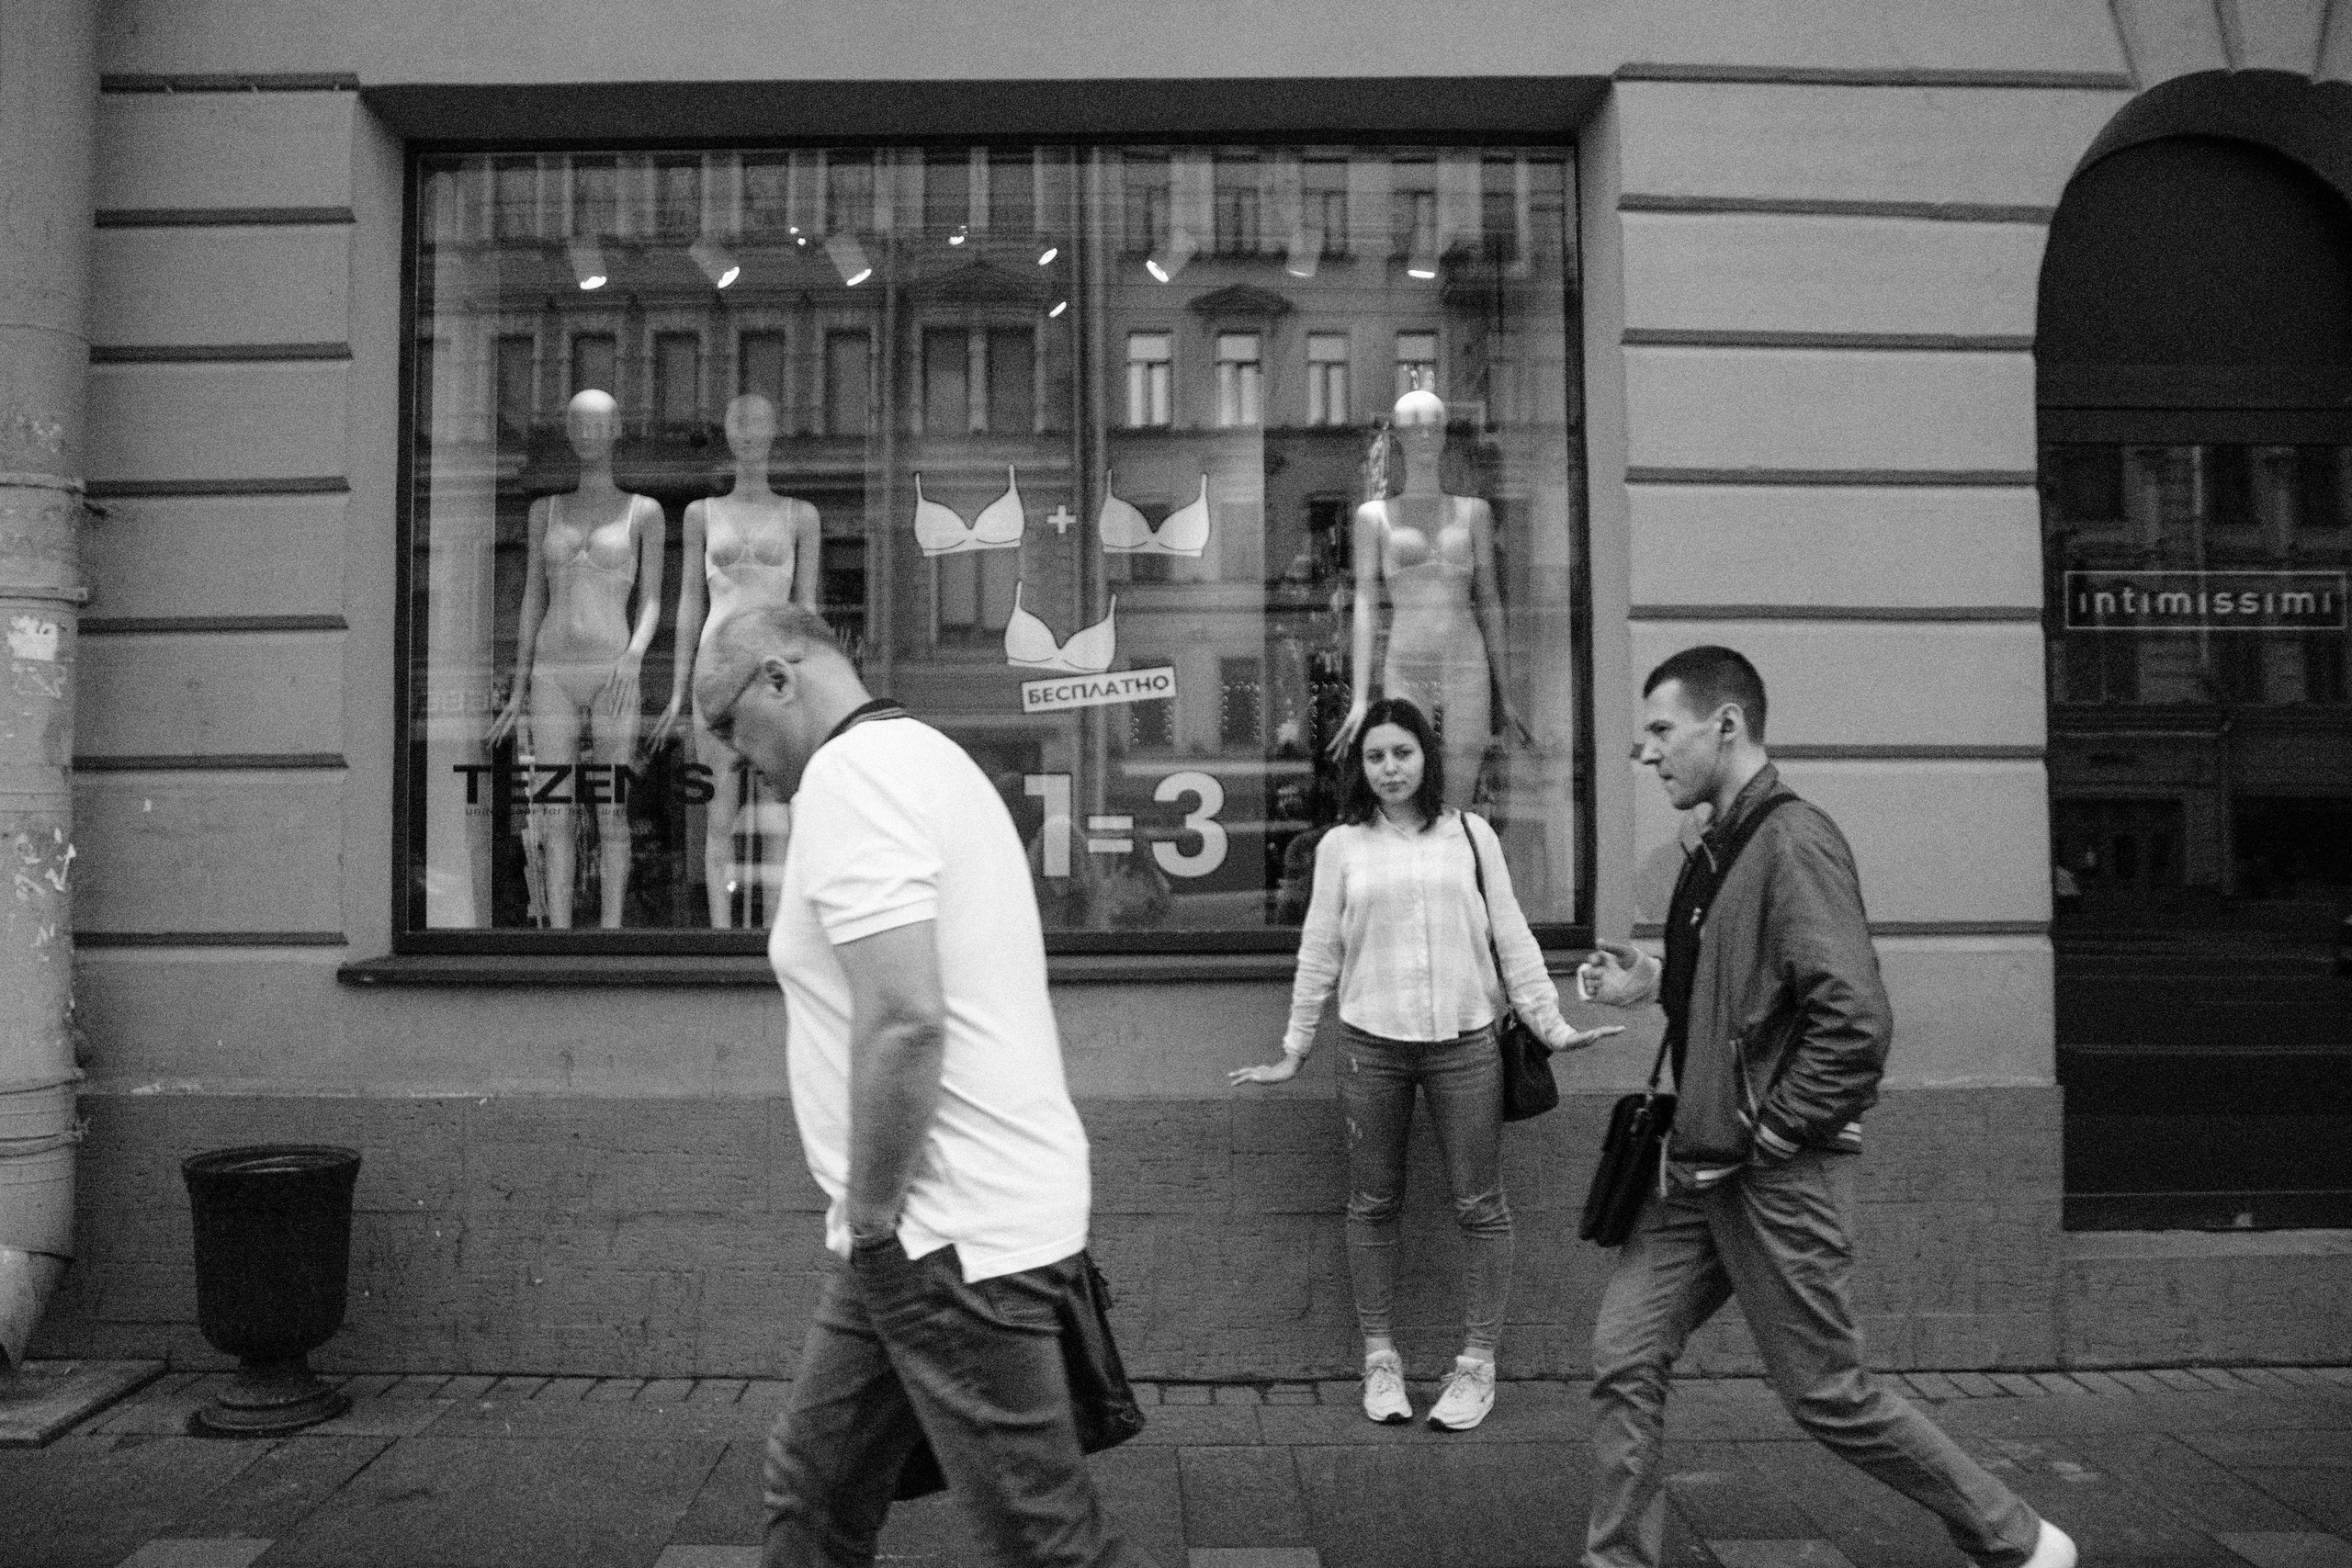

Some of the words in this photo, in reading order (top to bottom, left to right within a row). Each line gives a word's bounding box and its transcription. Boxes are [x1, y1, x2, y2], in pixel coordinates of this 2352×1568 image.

[2078, 586, 2332, 615] intimissimi
[1026, 675, 1170, 705] БЕСПЛАТНО
[452, 762, 716, 805] TEZENS
